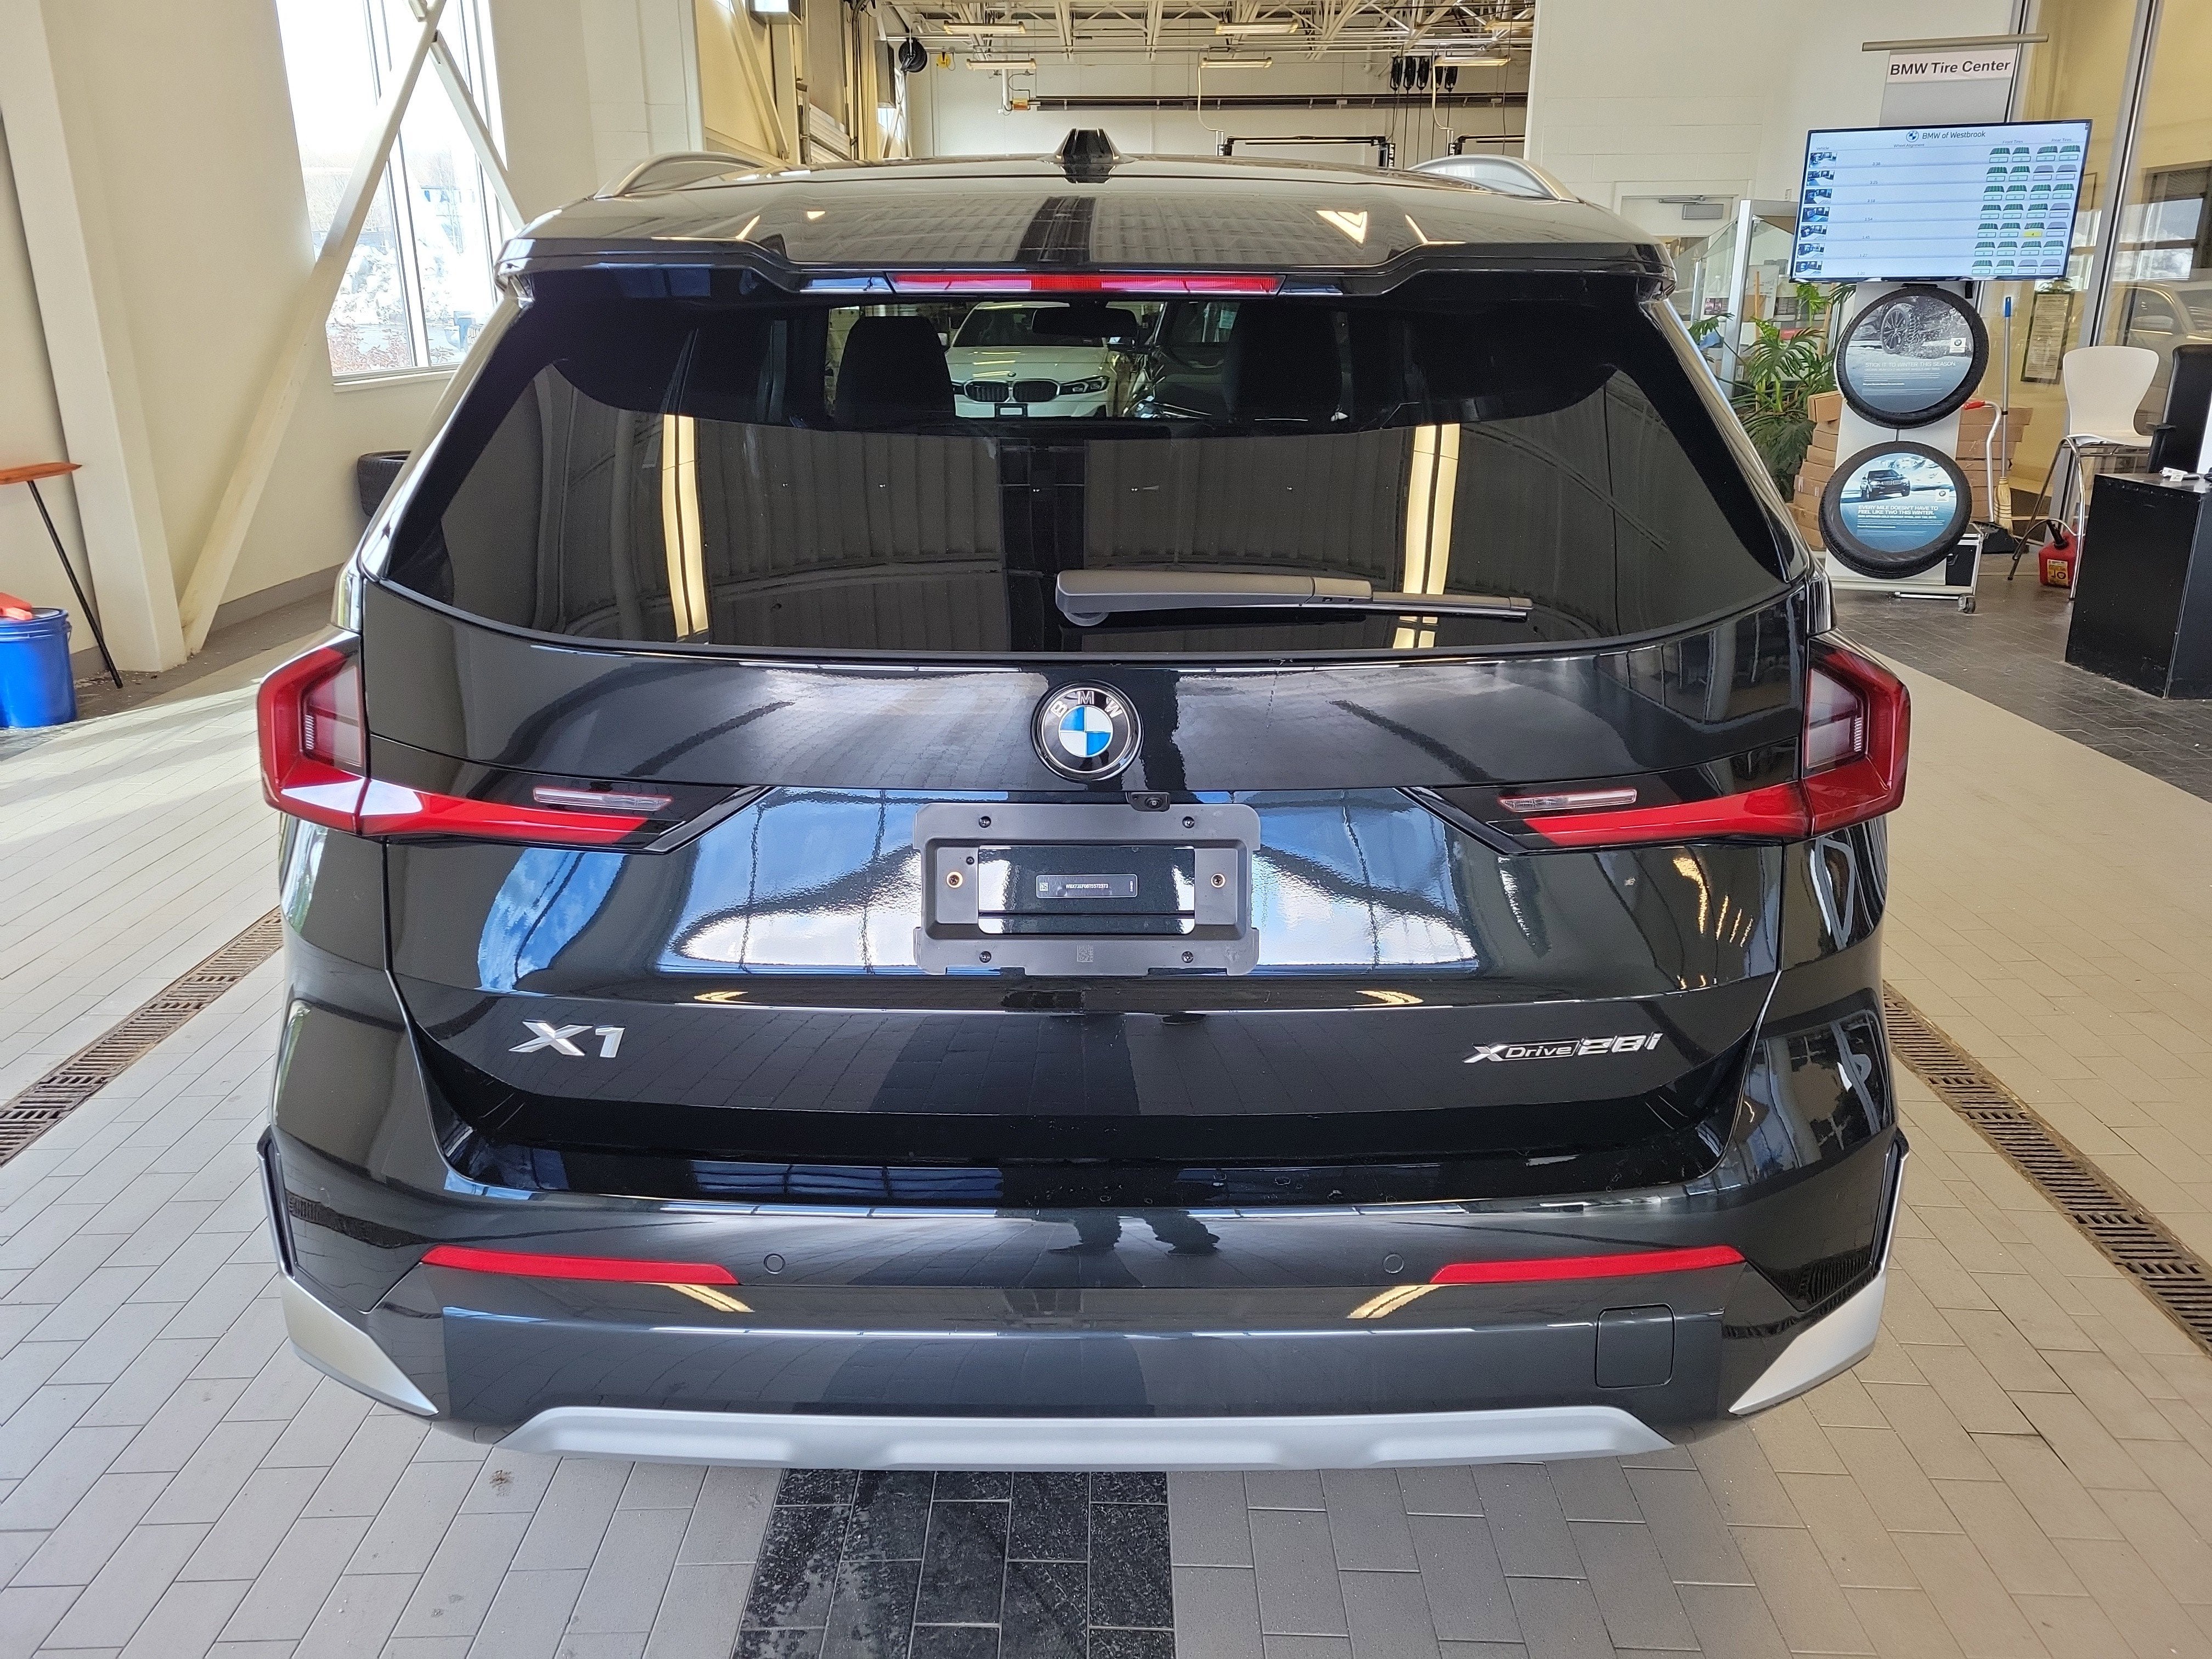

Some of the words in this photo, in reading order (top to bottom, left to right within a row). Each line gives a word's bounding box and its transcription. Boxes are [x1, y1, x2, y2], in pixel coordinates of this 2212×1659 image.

[1890, 63, 1928, 75] BMW
[1931, 62, 1958, 74] Tire
[1962, 60, 2011, 72] Center
[1051, 691, 1123, 718] BMW
[509, 1019, 626, 1058] X1
